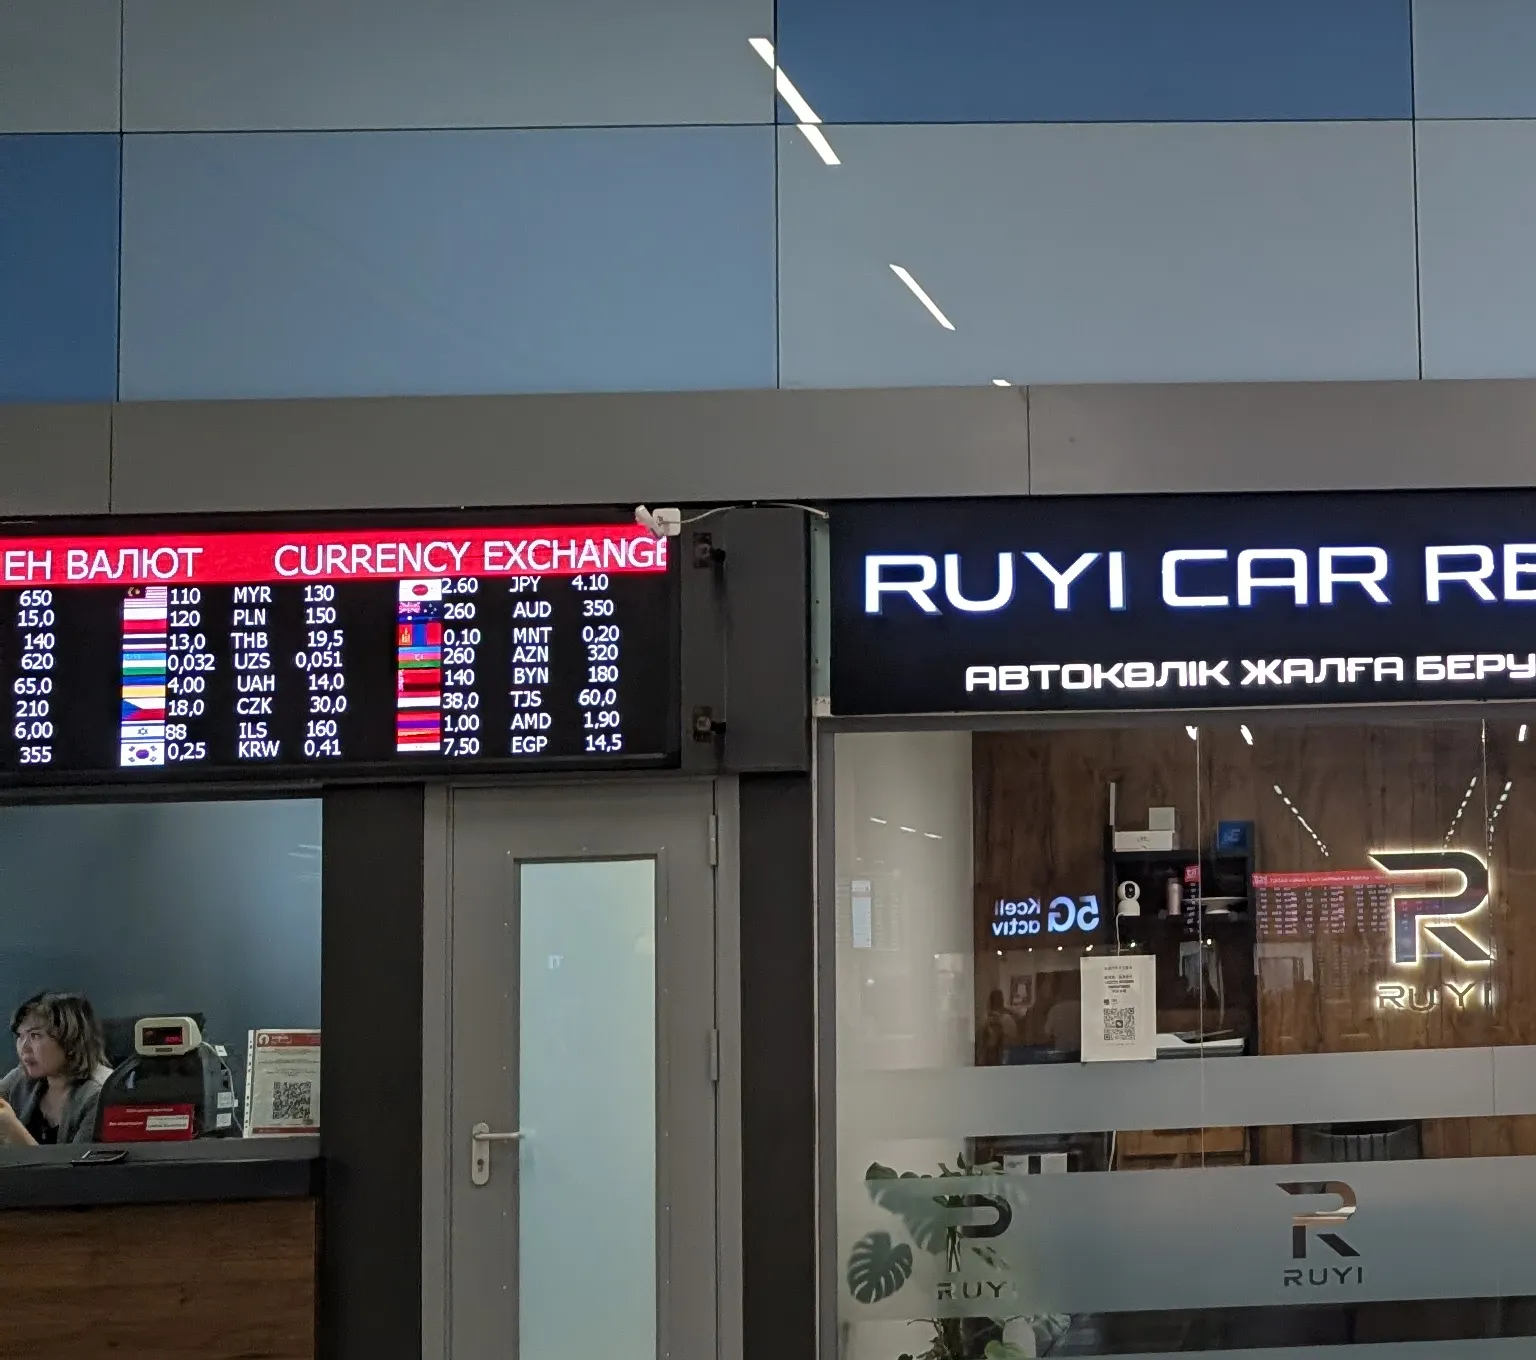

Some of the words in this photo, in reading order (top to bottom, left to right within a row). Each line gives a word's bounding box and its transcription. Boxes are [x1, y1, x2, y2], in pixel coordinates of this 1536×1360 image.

[67, 548, 203, 579] ВАЛЮТ
[274, 541, 471, 577] CURRENCY
[484, 537, 667, 571] EXCHANGE
[20, 590, 52, 606] 650
[170, 589, 200, 604] 110
[234, 587, 272, 603] MYR
[304, 585, 334, 602] 130
[442, 578, 478, 594] 2.60
[510, 576, 541, 593] JPY
[572, 575, 608, 591] 4.10
[863, 550, 1126, 615] RUYI
[1161, 546, 1391, 608] CAR
[17, 611, 54, 627] 15,0
[170, 611, 200, 626] 120
[234, 609, 266, 625] PLN
[306, 607, 336, 624] 150
[444, 603, 476, 619] 260
[513, 601, 551, 618] AUD
[583, 600, 613, 616] 350
[24, 634, 54, 649] 140
[170, 634, 205, 651] 13,0
[231, 632, 268, 648] THB
[308, 630, 343, 648] 19,5
[444, 629, 480, 646] 0,10
[514, 628, 552, 643] MNT
[582, 626, 619, 643] 0,20
[22, 654, 53, 669] 620
[168, 654, 215, 672] 0,032
[235, 653, 271, 668] UZS
[295, 653, 343, 670] 0,051
[443, 648, 474, 664] 260
[513, 646, 549, 663] AZN
[587, 645, 618, 660] 320
[14, 678, 52, 695] 65,0
[168, 676, 204, 694] 4,00
[237, 675, 275, 691] UAH
[309, 674, 344, 691] 14,0
[445, 669, 474, 685] 140
[514, 668, 549, 684] BYN
[588, 666, 618, 682] 180
[965, 660, 1230, 693] АВТОКӨЛІК
[1240, 655, 1405, 686] ЖАЛҒА
[16, 701, 48, 717] 210
[168, 699, 204, 717] 18,0
[237, 698, 272, 714] CZK
[310, 696, 346, 713] 30,0
[443, 692, 479, 710] 38,0
[510, 691, 542, 707] TJS
[578, 690, 616, 706] 60,0
[15, 722, 53, 739] 6,00
[165, 725, 187, 739] 88
[239, 722, 267, 738] ILS
[307, 720, 336, 737] 160
[444, 715, 479, 732] 1,00
[511, 713, 551, 729] AMD
[584, 711, 619, 728] 1,90
[20, 747, 52, 763] 355
[168, 743, 205, 761] 0,25
[238, 741, 279, 757] KRW
[304, 740, 341, 757] 0,41
[444, 738, 479, 755] 7,50
[512, 737, 548, 753] EGP
[586, 735, 621, 751] 14,5
[1378, 982, 1492, 1012] RUYI
[1284, 1266, 1363, 1287] RUYI
